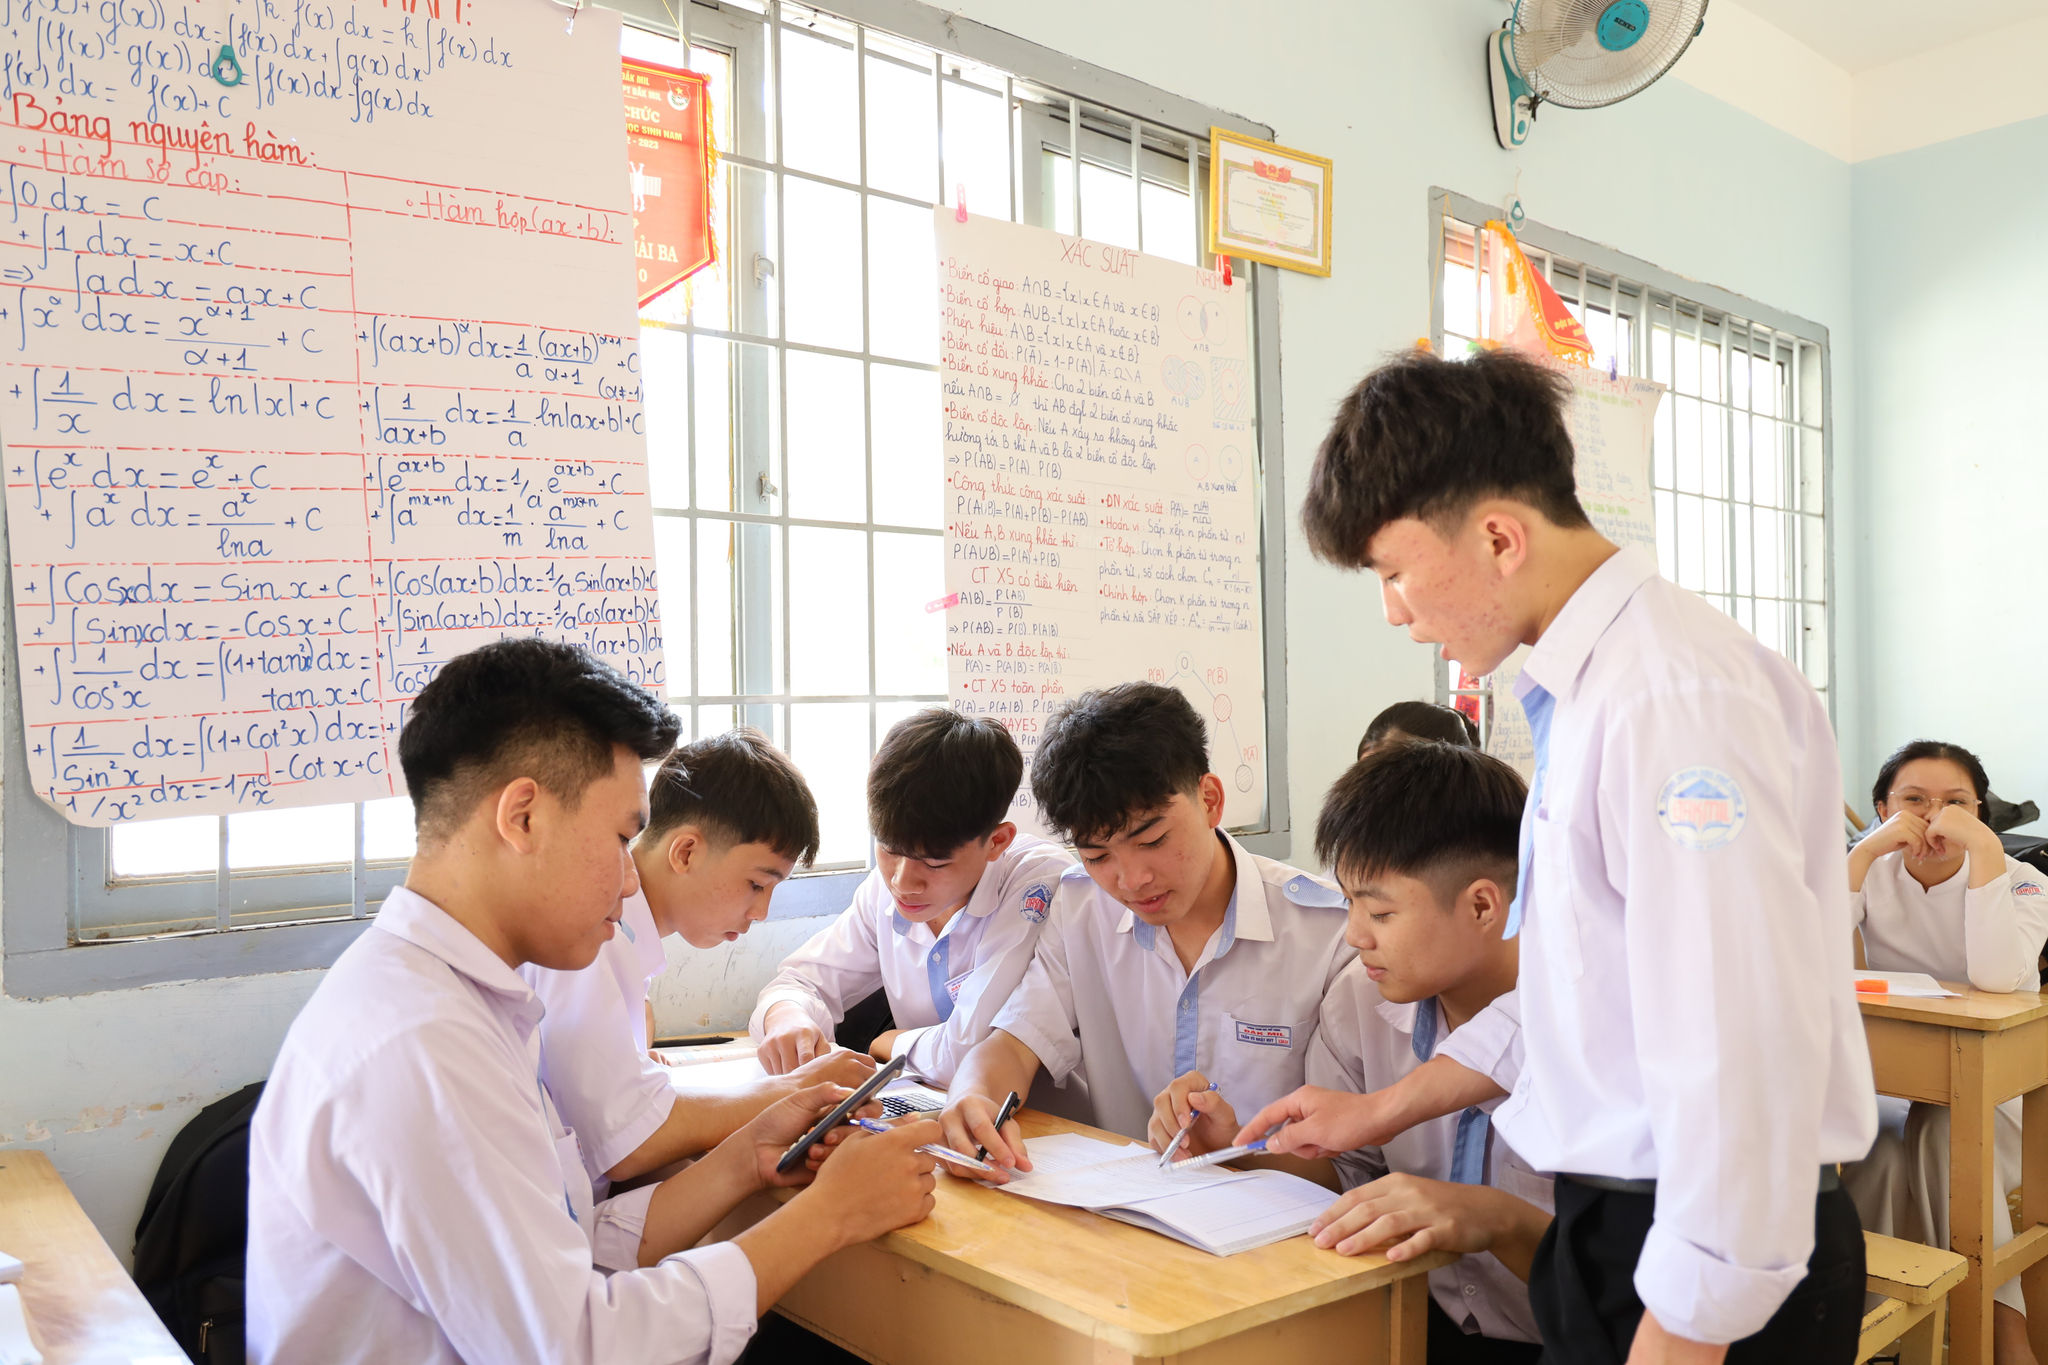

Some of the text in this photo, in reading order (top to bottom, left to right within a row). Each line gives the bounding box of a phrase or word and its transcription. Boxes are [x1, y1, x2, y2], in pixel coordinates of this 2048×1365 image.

[13, 92, 111, 158] Bảng
[129, 121, 234, 171] nguyên
[663, 129, 683, 141] NAM
[36, 138, 128, 179] Hàm
[413, 190, 485, 223] Hàm
[657, 243, 679, 263] BA
